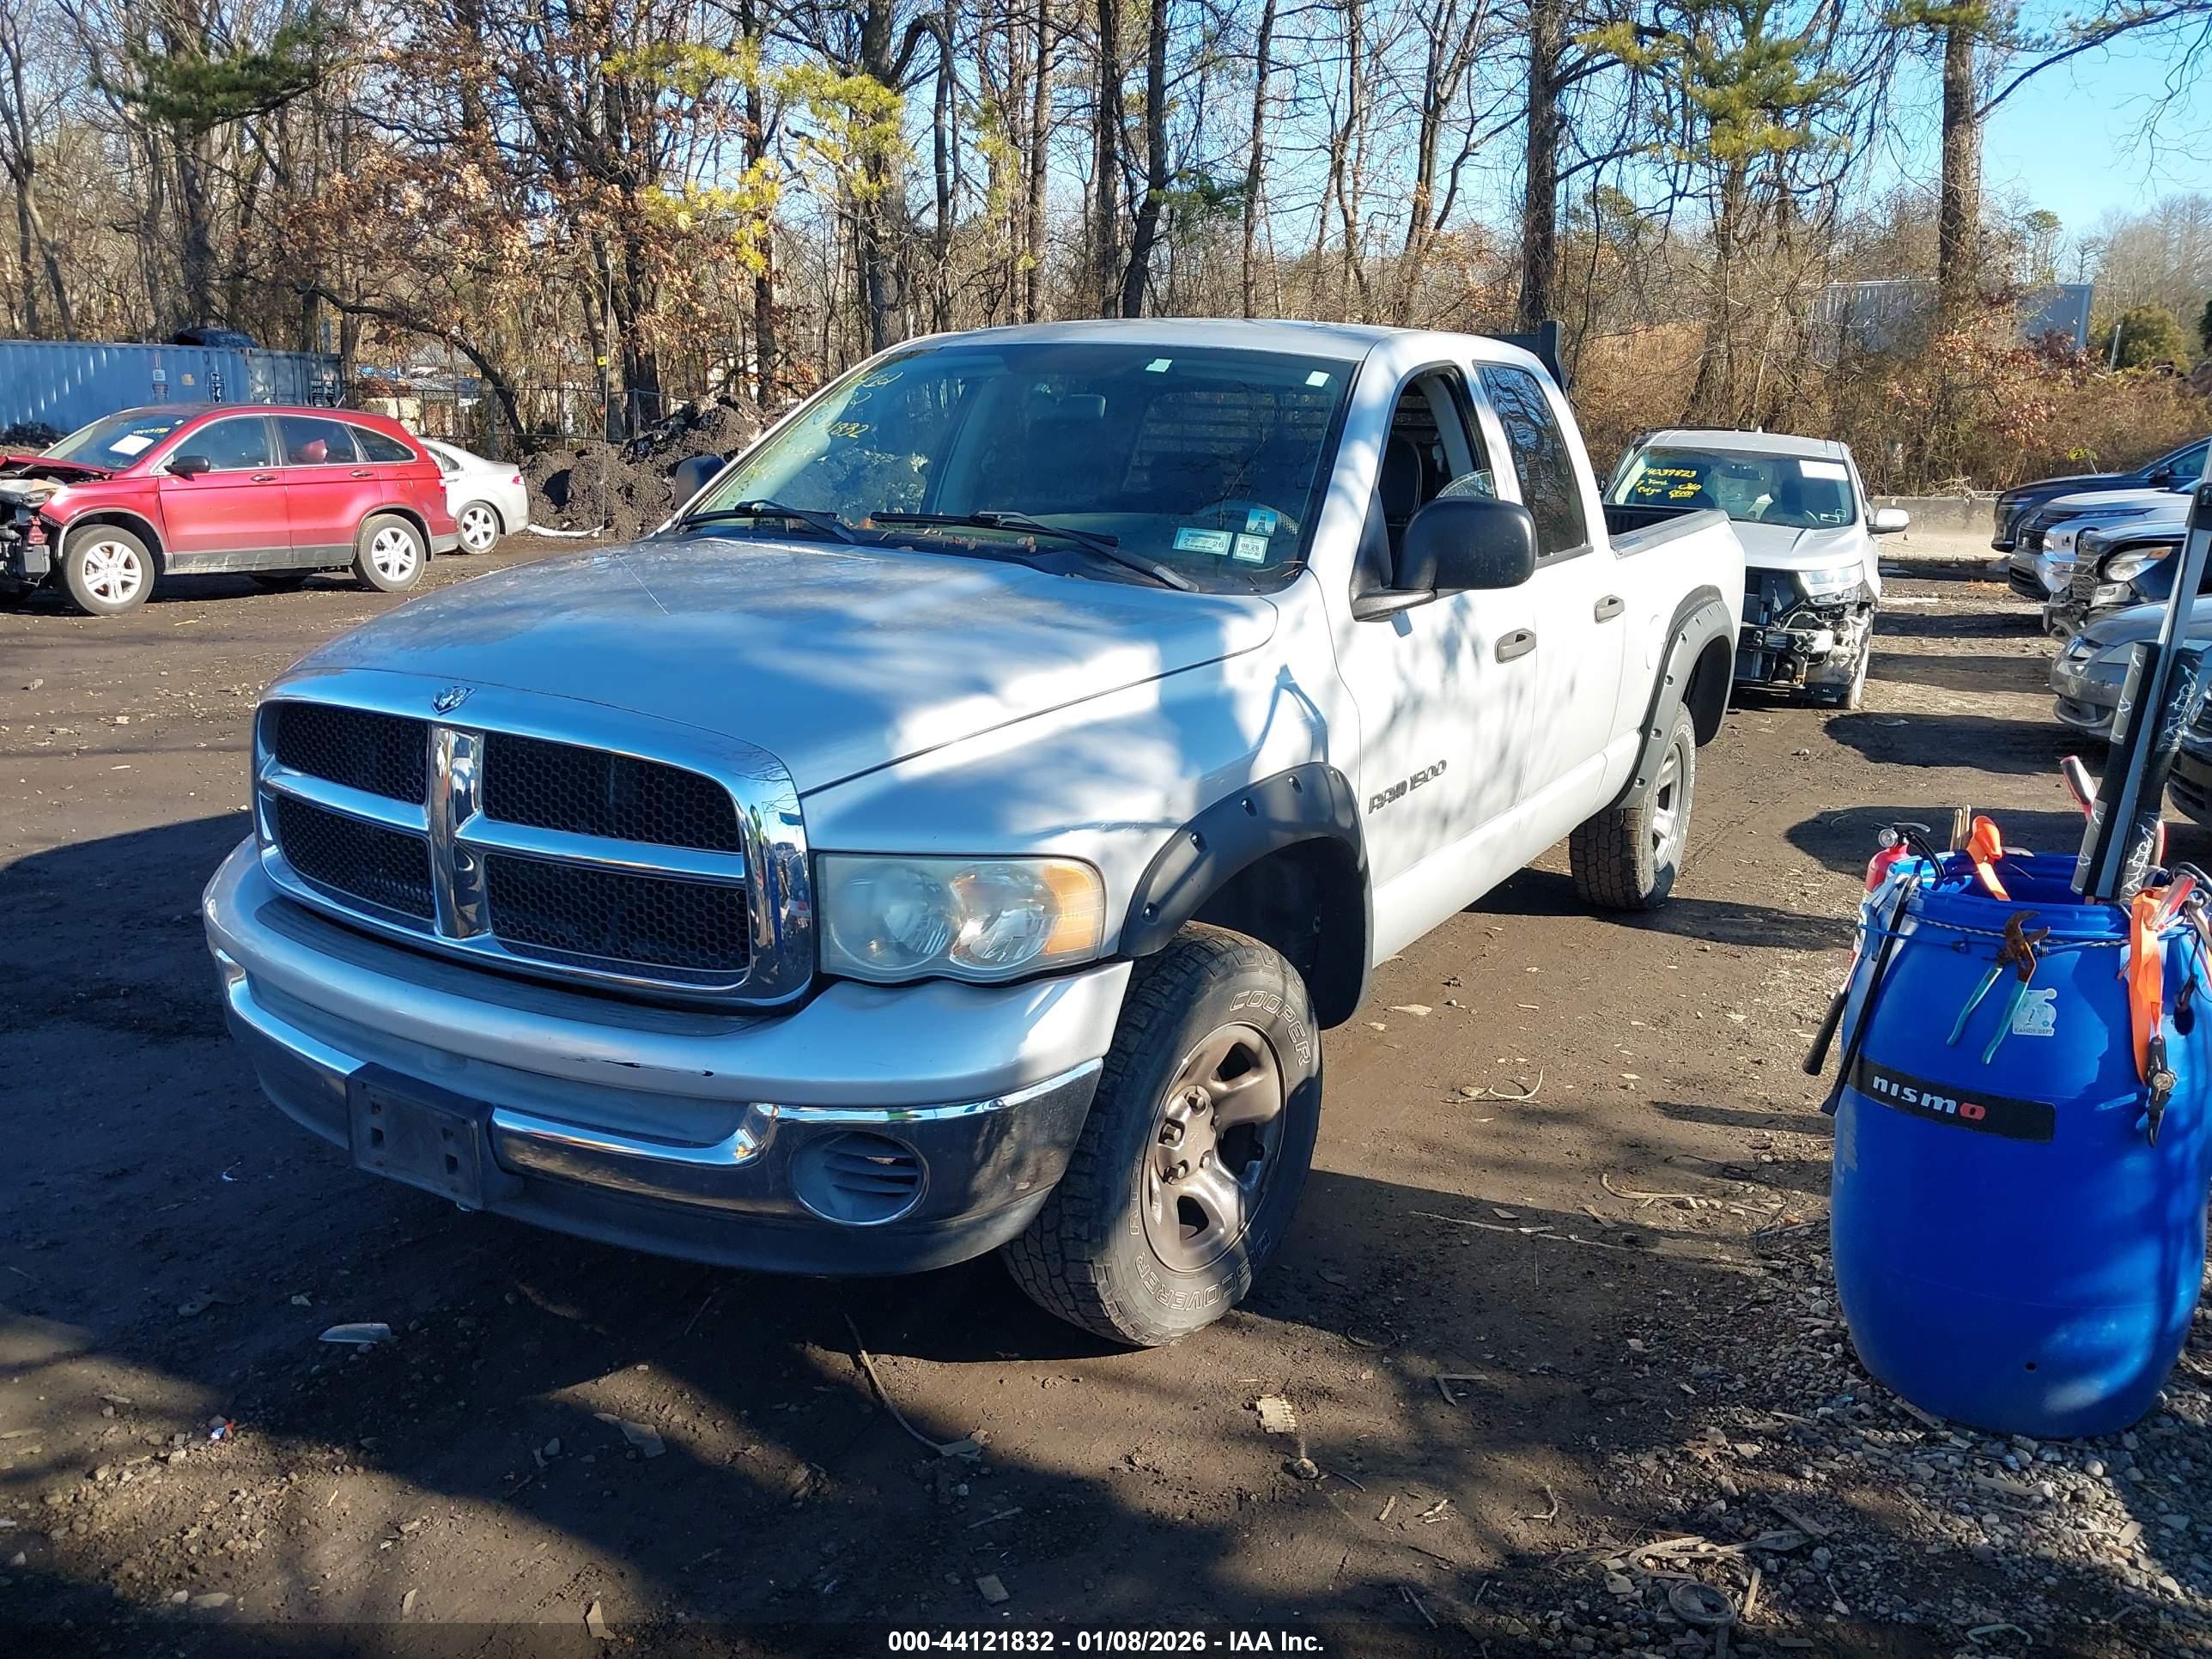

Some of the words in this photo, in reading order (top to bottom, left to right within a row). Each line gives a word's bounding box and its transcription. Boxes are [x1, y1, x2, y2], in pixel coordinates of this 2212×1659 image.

[1409, 759, 1447, 792] 1500
[1229, 990, 1311, 1067] COOPER
[1872, 1075, 1986, 1121] nismo
[1135, 1229, 1272, 1311] DISCOVERER
